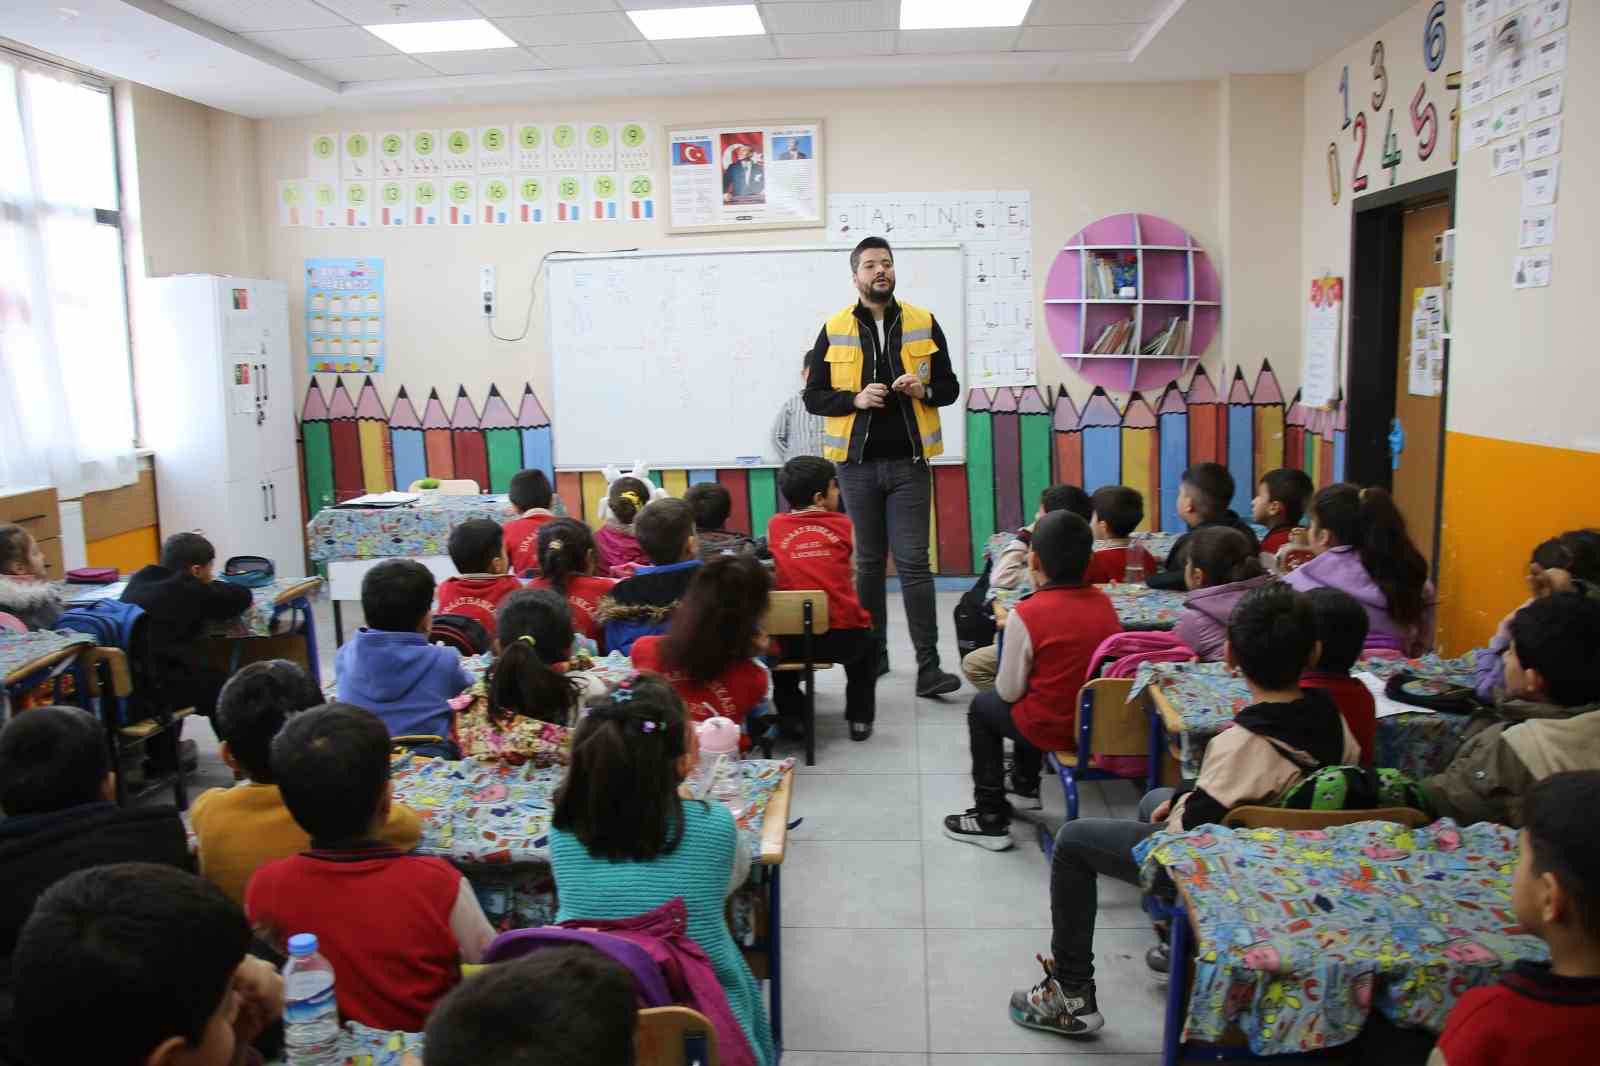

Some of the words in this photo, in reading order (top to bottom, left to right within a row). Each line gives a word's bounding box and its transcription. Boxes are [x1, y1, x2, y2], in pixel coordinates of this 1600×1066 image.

[1424, 0, 1447, 72] 6
[1339, 65, 1352, 130] 1
[1370, 40, 1388, 112] 3
[1352, 111, 1369, 193] 2
[1381, 108, 1402, 186] 4
[1409, 81, 1438, 162] 5
[1328, 142, 1340, 206] 0
[871, 207, 884, 224] A
[938, 206, 954, 224] N
[975, 208, 985, 219] e
[1007, 205, 1019, 224] E
[1007, 256, 1020, 275] T
